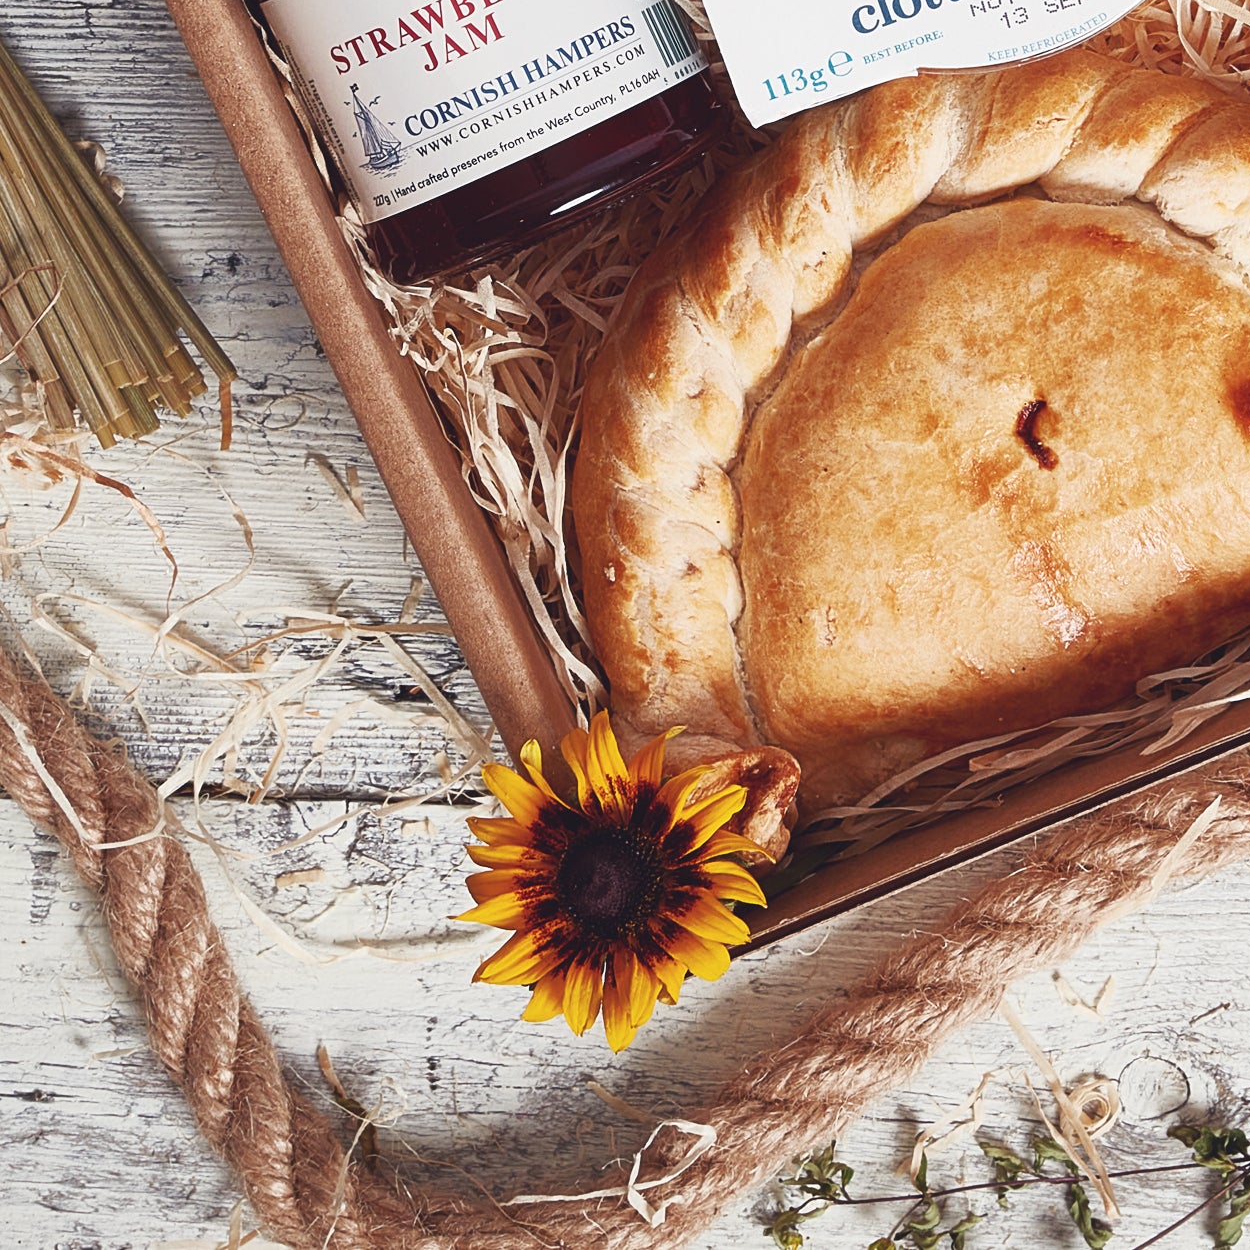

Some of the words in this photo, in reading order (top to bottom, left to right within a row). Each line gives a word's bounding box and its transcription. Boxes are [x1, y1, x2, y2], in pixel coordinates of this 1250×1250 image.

[421, 12, 505, 71] JAM
[988, 48, 1018, 61] KEEP
[1022, 13, 1108, 54] REFRIGERATED
[1000, 7, 1028, 28] 13
[405, 71, 519, 136] CORNISH
[521, 16, 635, 84] HAMPERS
[416, 44, 644, 157] WWW.CORNISHHAMPERS.COM
[762, 68, 828, 101] 113g
[863, 46, 892, 65] BEST
[894, 30, 944, 54] BEFORE:
[373, 194, 391, 207] 227g
[394, 182, 416, 198] Hand
[418, 168, 449, 189] crafted
[451, 149, 498, 177] preserves
[499, 137, 525, 152] from
[527, 128, 544, 139] the
[545, 113, 573, 130] West
[575, 94, 616, 116] Country,
[619, 79, 641, 95] PL16
